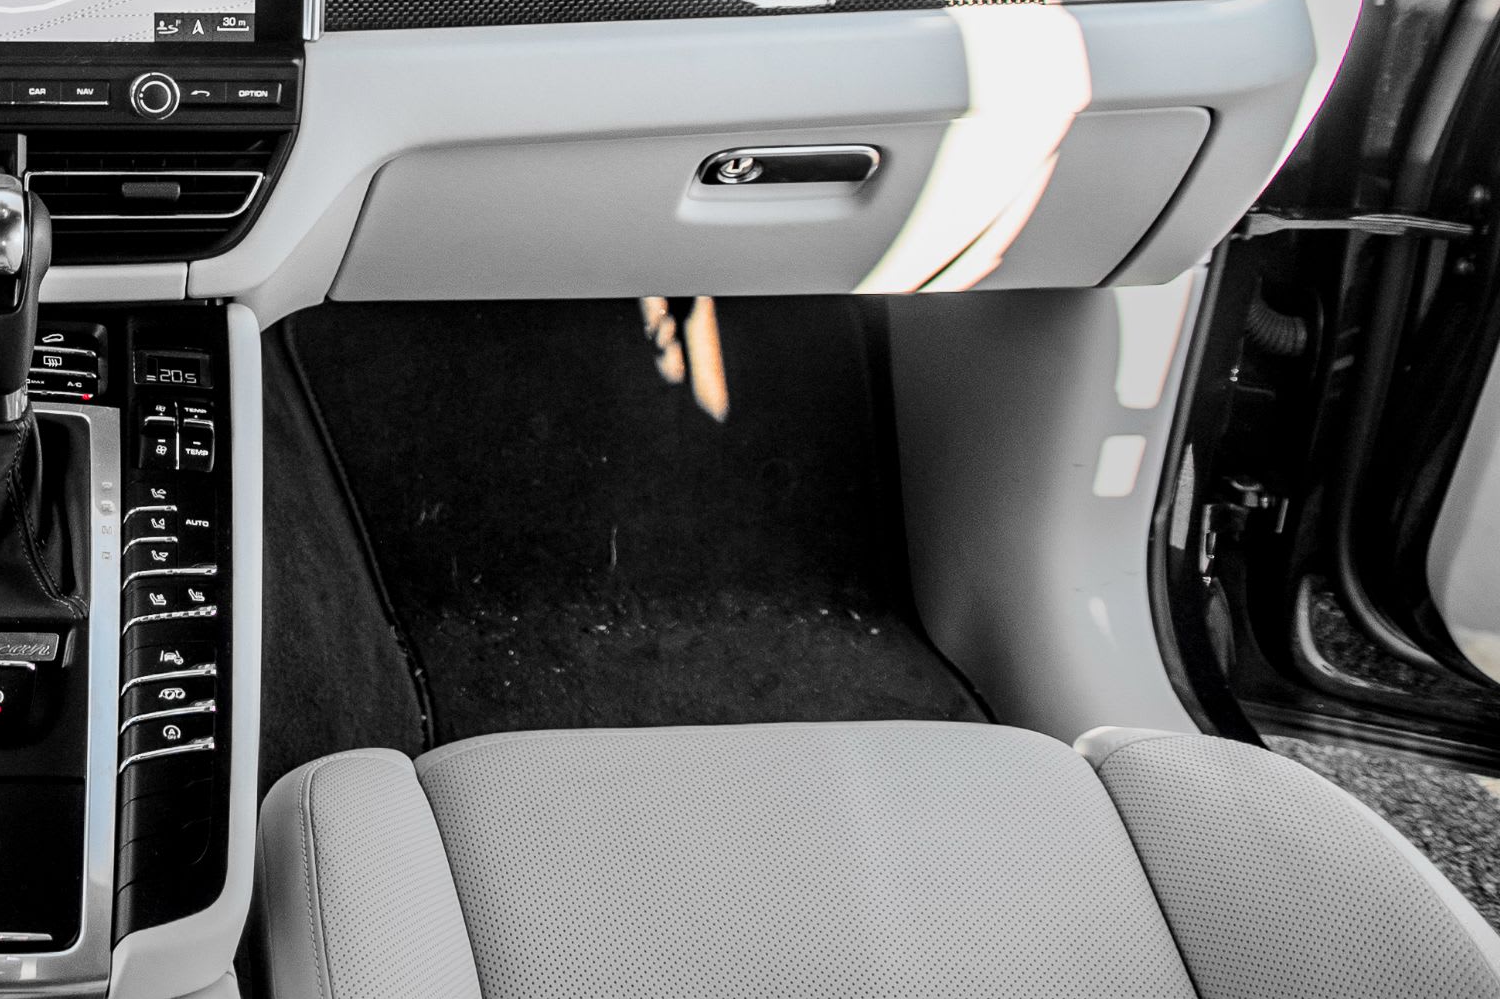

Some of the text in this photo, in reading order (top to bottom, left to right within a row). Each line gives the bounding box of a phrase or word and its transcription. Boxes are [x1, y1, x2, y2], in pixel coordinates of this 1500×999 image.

[223, 17, 236, 27] 30
[238, 90, 268, 98] OPTION
[159, 369, 197, 384] 20.5
[185, 448, 209, 456] TEMP
[185, 519, 209, 527] AUTO
